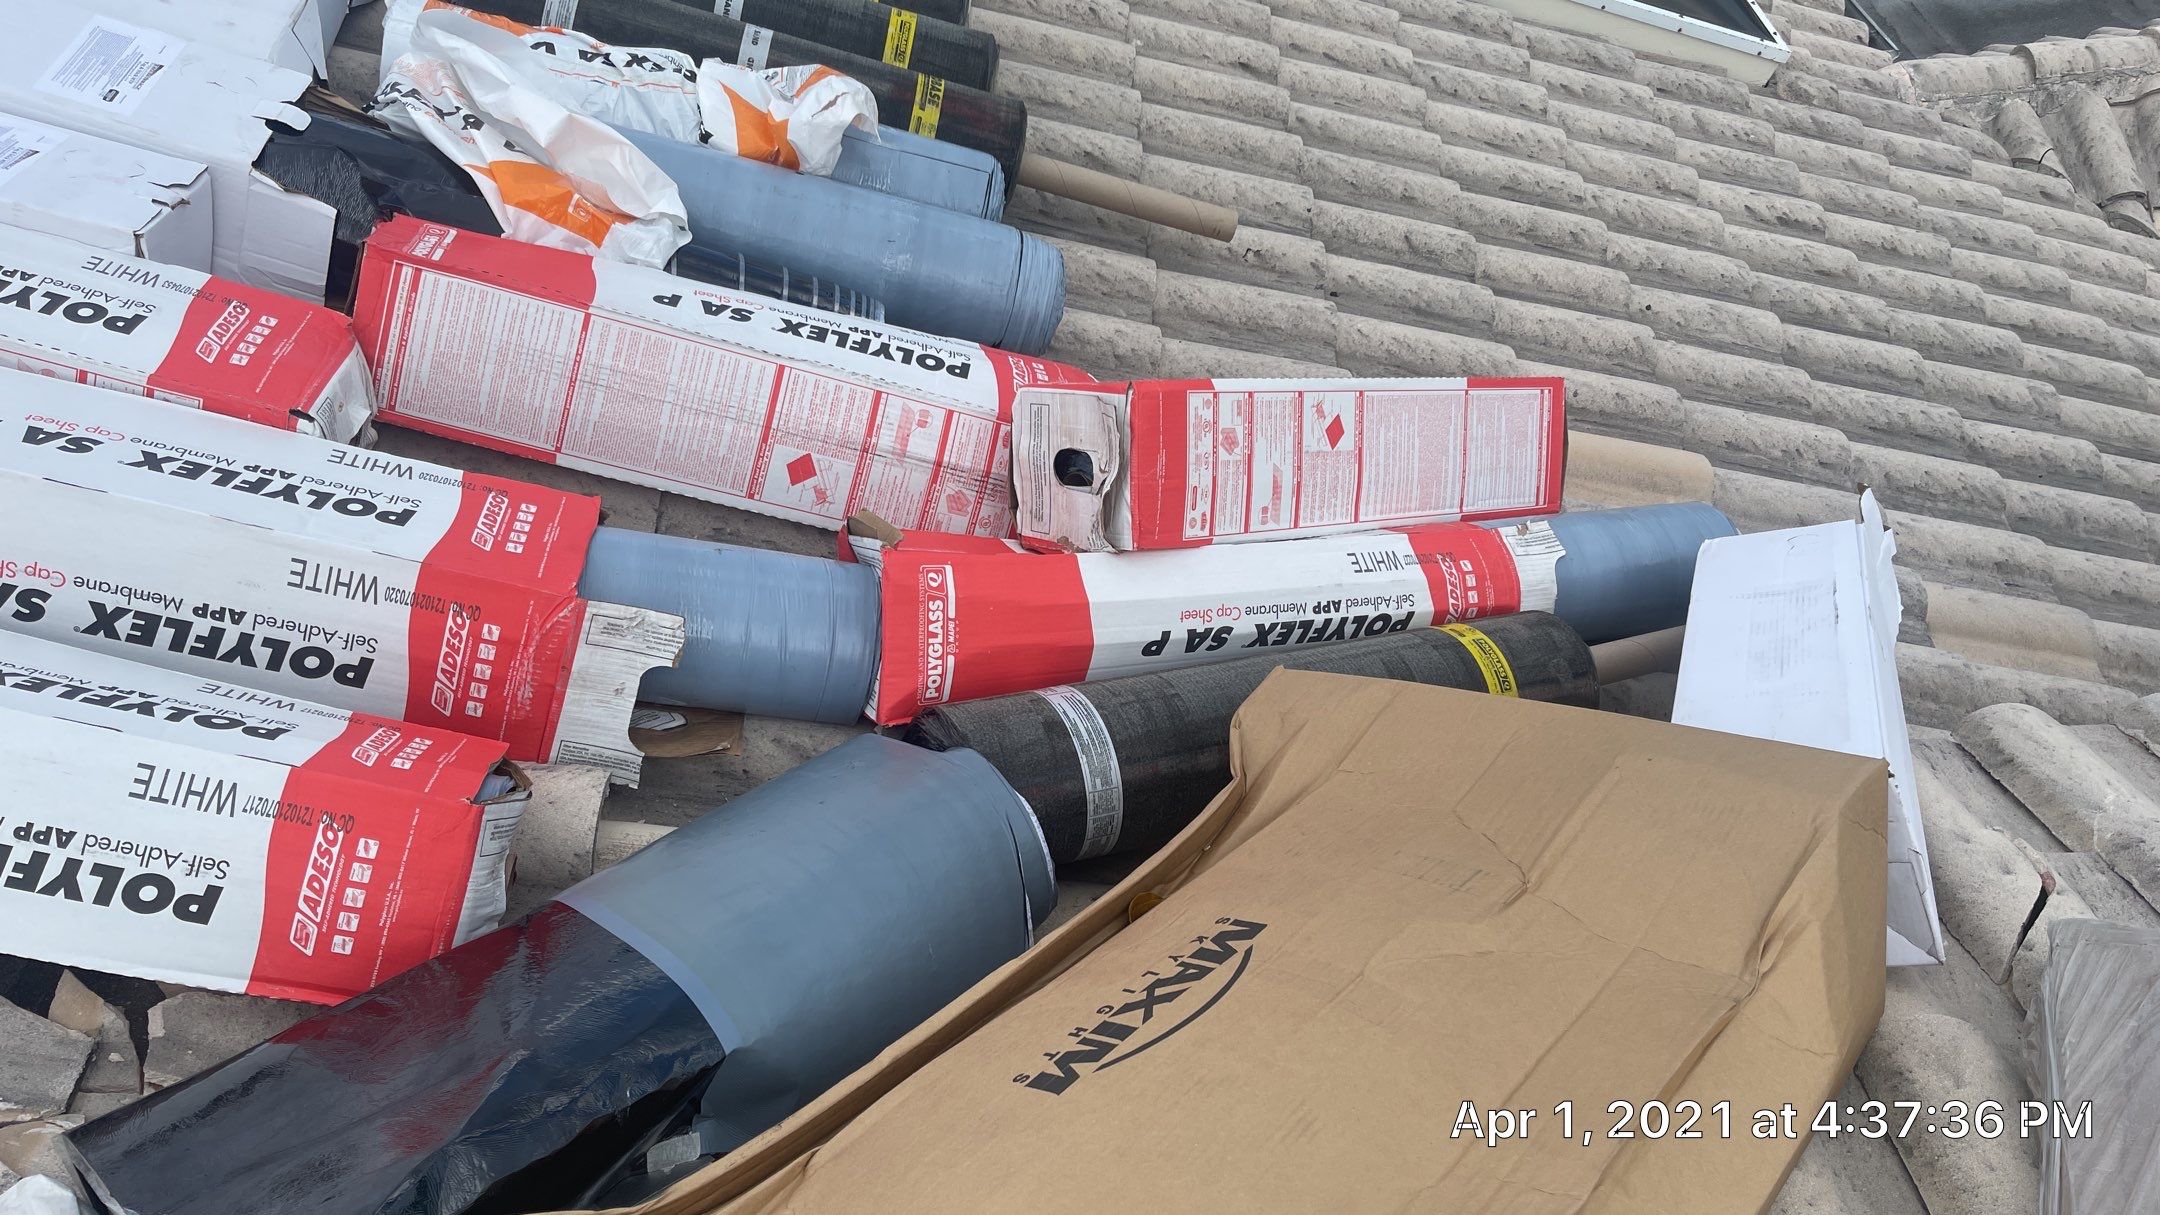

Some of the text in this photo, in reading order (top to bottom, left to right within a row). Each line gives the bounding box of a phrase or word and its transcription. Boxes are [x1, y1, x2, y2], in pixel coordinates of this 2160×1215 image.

[81, 256, 160, 288] WHITE
[38, 277, 156, 313] Self-Adhered
[652, 293, 683, 308] P
[691, 289, 732, 304] Sheet
[733, 296, 765, 311] Cap
[700, 300, 756, 323] SA
[768, 306, 843, 330] Membrane
[848, 326, 884, 340] APP
[887, 333, 972, 362] Self-Adhered
[774, 318, 973, 380] POLYFLEX
[19, 425, 104, 455] SA
[21, 414, 422, 508] Self-Adhered APP Membrane Cap Sheet
[326, 449, 414, 480] WHITE
[419, 472, 477, 491] T21021070320
[478, 492, 508, 536] ADESO
[25, 562, 66, 590] Cap
[1347, 551, 1404, 574] WHITE
[73, 576, 184, 614] Membrane
[286, 557, 379, 606] WHITE
[1437, 554, 1461, 618] ADESO
[191, 603, 248, 626] APP
[384, 586, 482, 622] QC No: T21021070320
[1179, 593, 1416, 623] Self-Adhered APP Membrane Cap Sheet
[252, 614, 378, 654] Self-Adhered
[438, 605, 469, 688] ADESO
[948, 621, 956, 643] MAPEI
[1141, 630, 1172, 657] P
[1184, 625, 1236, 653] SA
[926, 599, 943, 699] POLYGLASS
[97, 685, 158, 700] APP
[196, 683, 297, 713] WHITE
[161, 696, 300, 730] Self-Adhered
[360, 728, 400, 754] ADESO
[127, 762, 239, 818] WHITE
[242, 795, 354, 835] QC No: T21021070217
[12, 821, 231, 880] Self-Adhered APP
[299, 815, 342, 922] ADESO
[330, 853, 346, 893] TECHNOLOGY
[1024, 919, 1268, 1096] MAXIM
